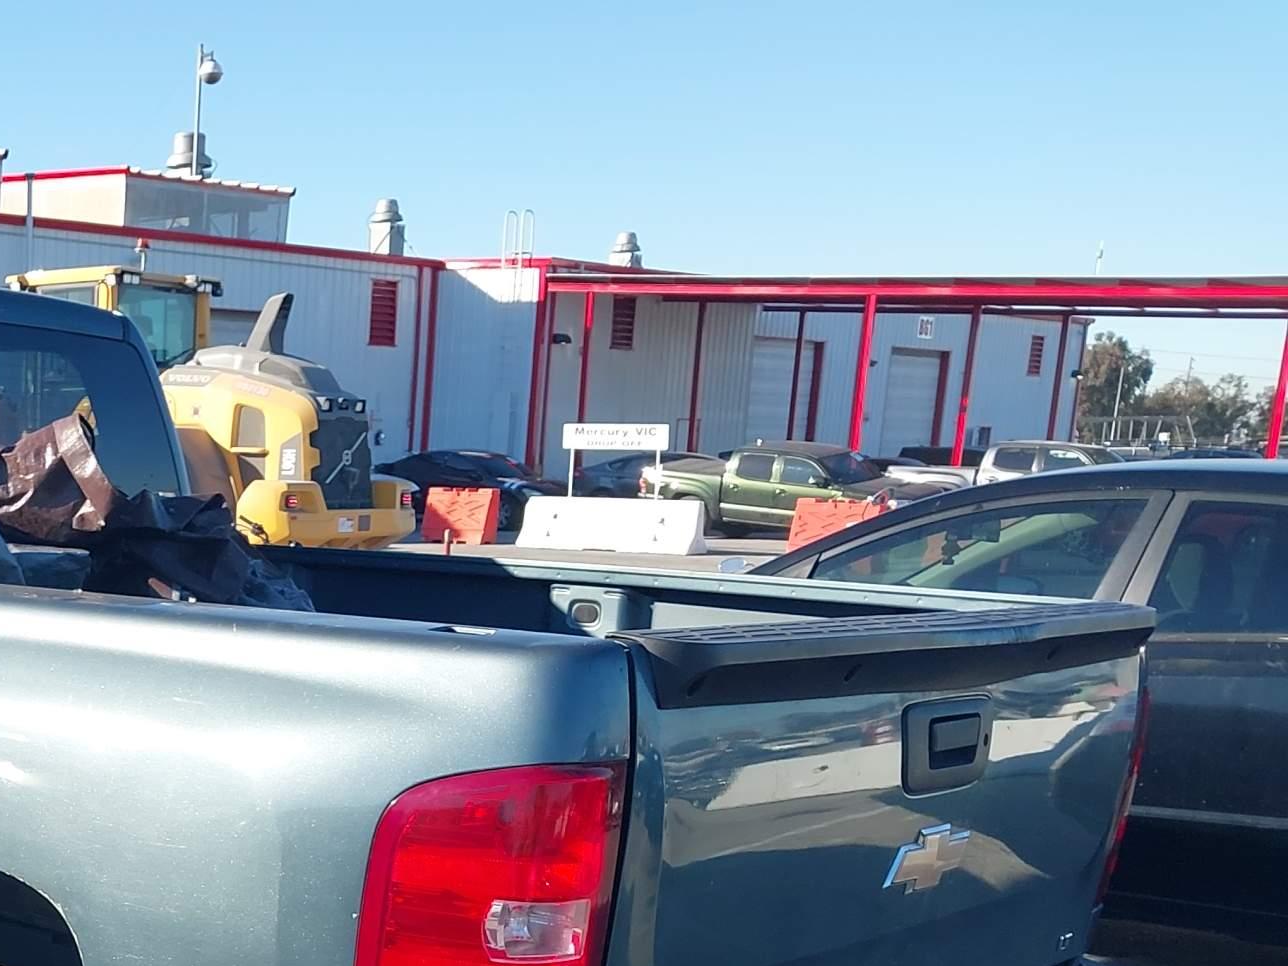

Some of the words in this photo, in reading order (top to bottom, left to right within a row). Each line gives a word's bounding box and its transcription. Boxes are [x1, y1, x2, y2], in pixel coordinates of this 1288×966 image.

[168, 374, 211, 383] VOLVO
[575, 427, 629, 437] Mercury
[635, 427, 657, 436] VIC
